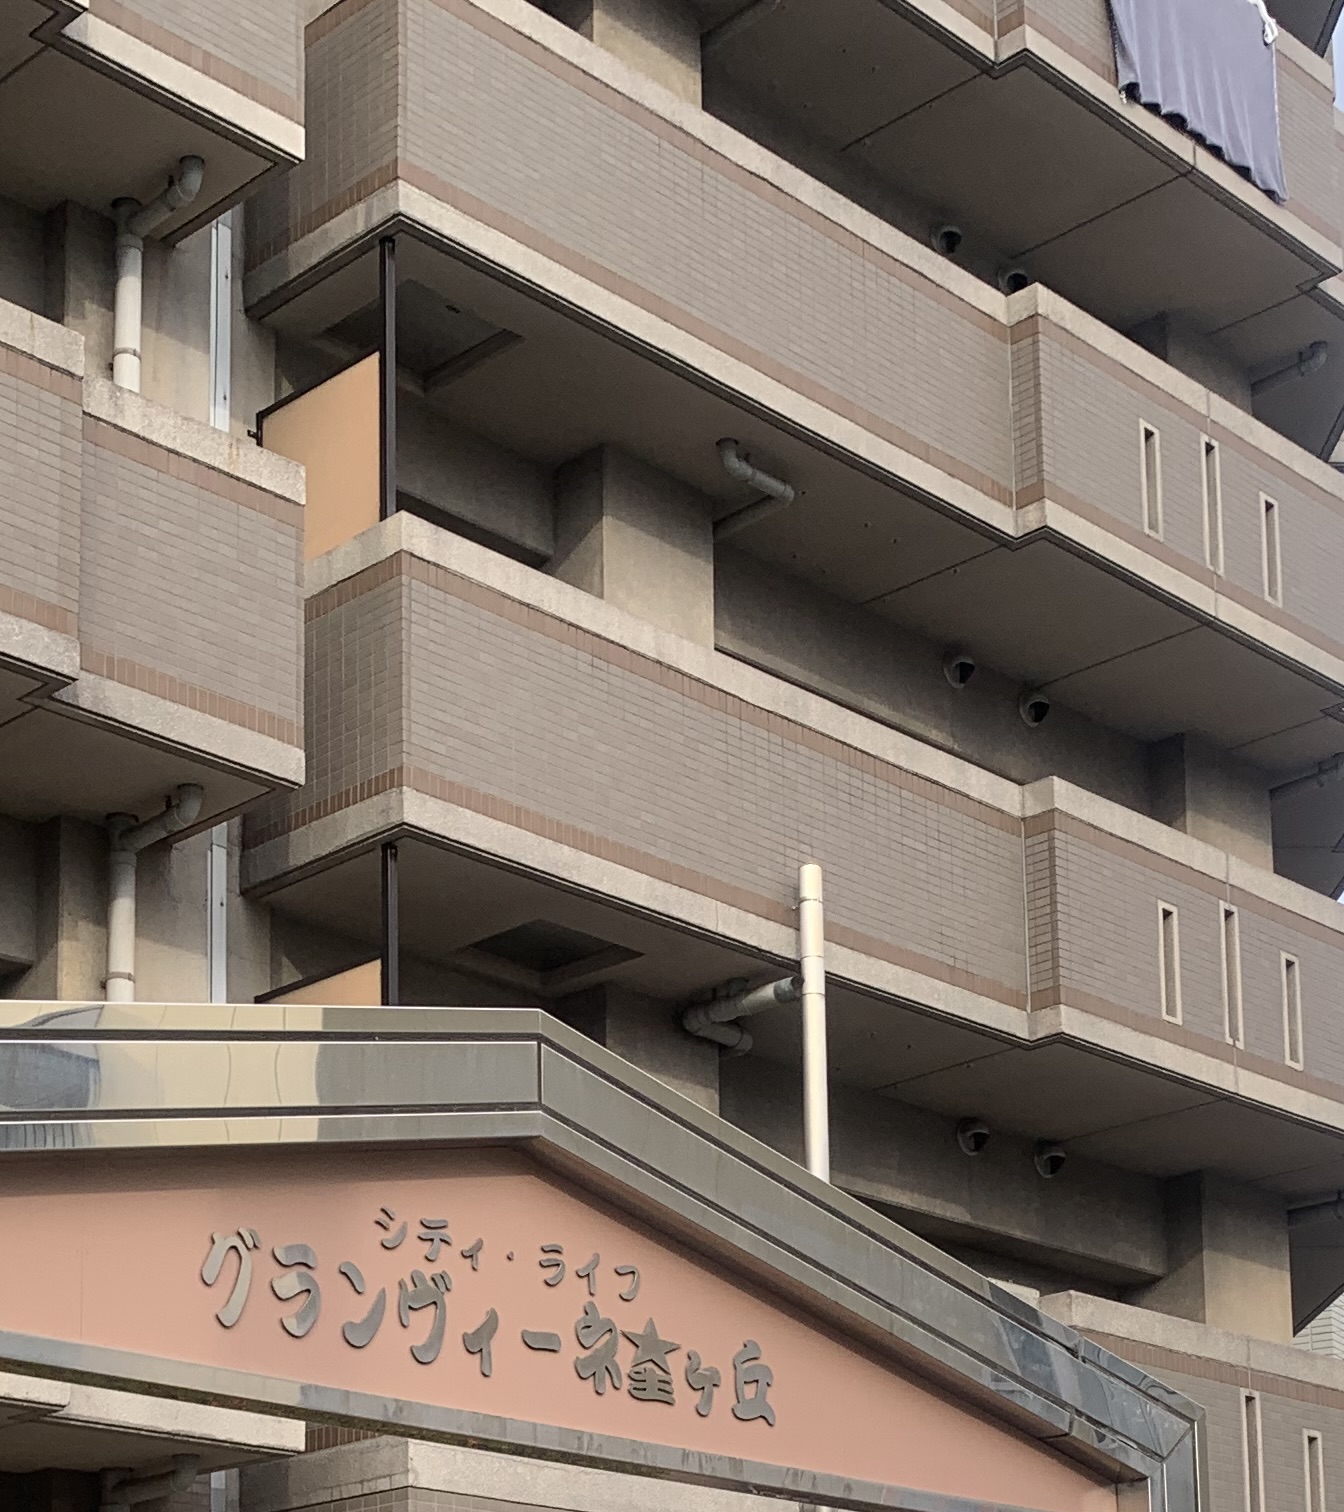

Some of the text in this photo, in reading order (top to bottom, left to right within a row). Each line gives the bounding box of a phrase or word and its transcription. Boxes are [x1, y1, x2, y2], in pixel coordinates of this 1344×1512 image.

[374, 1206, 642, 1301] シティ・ライフ
